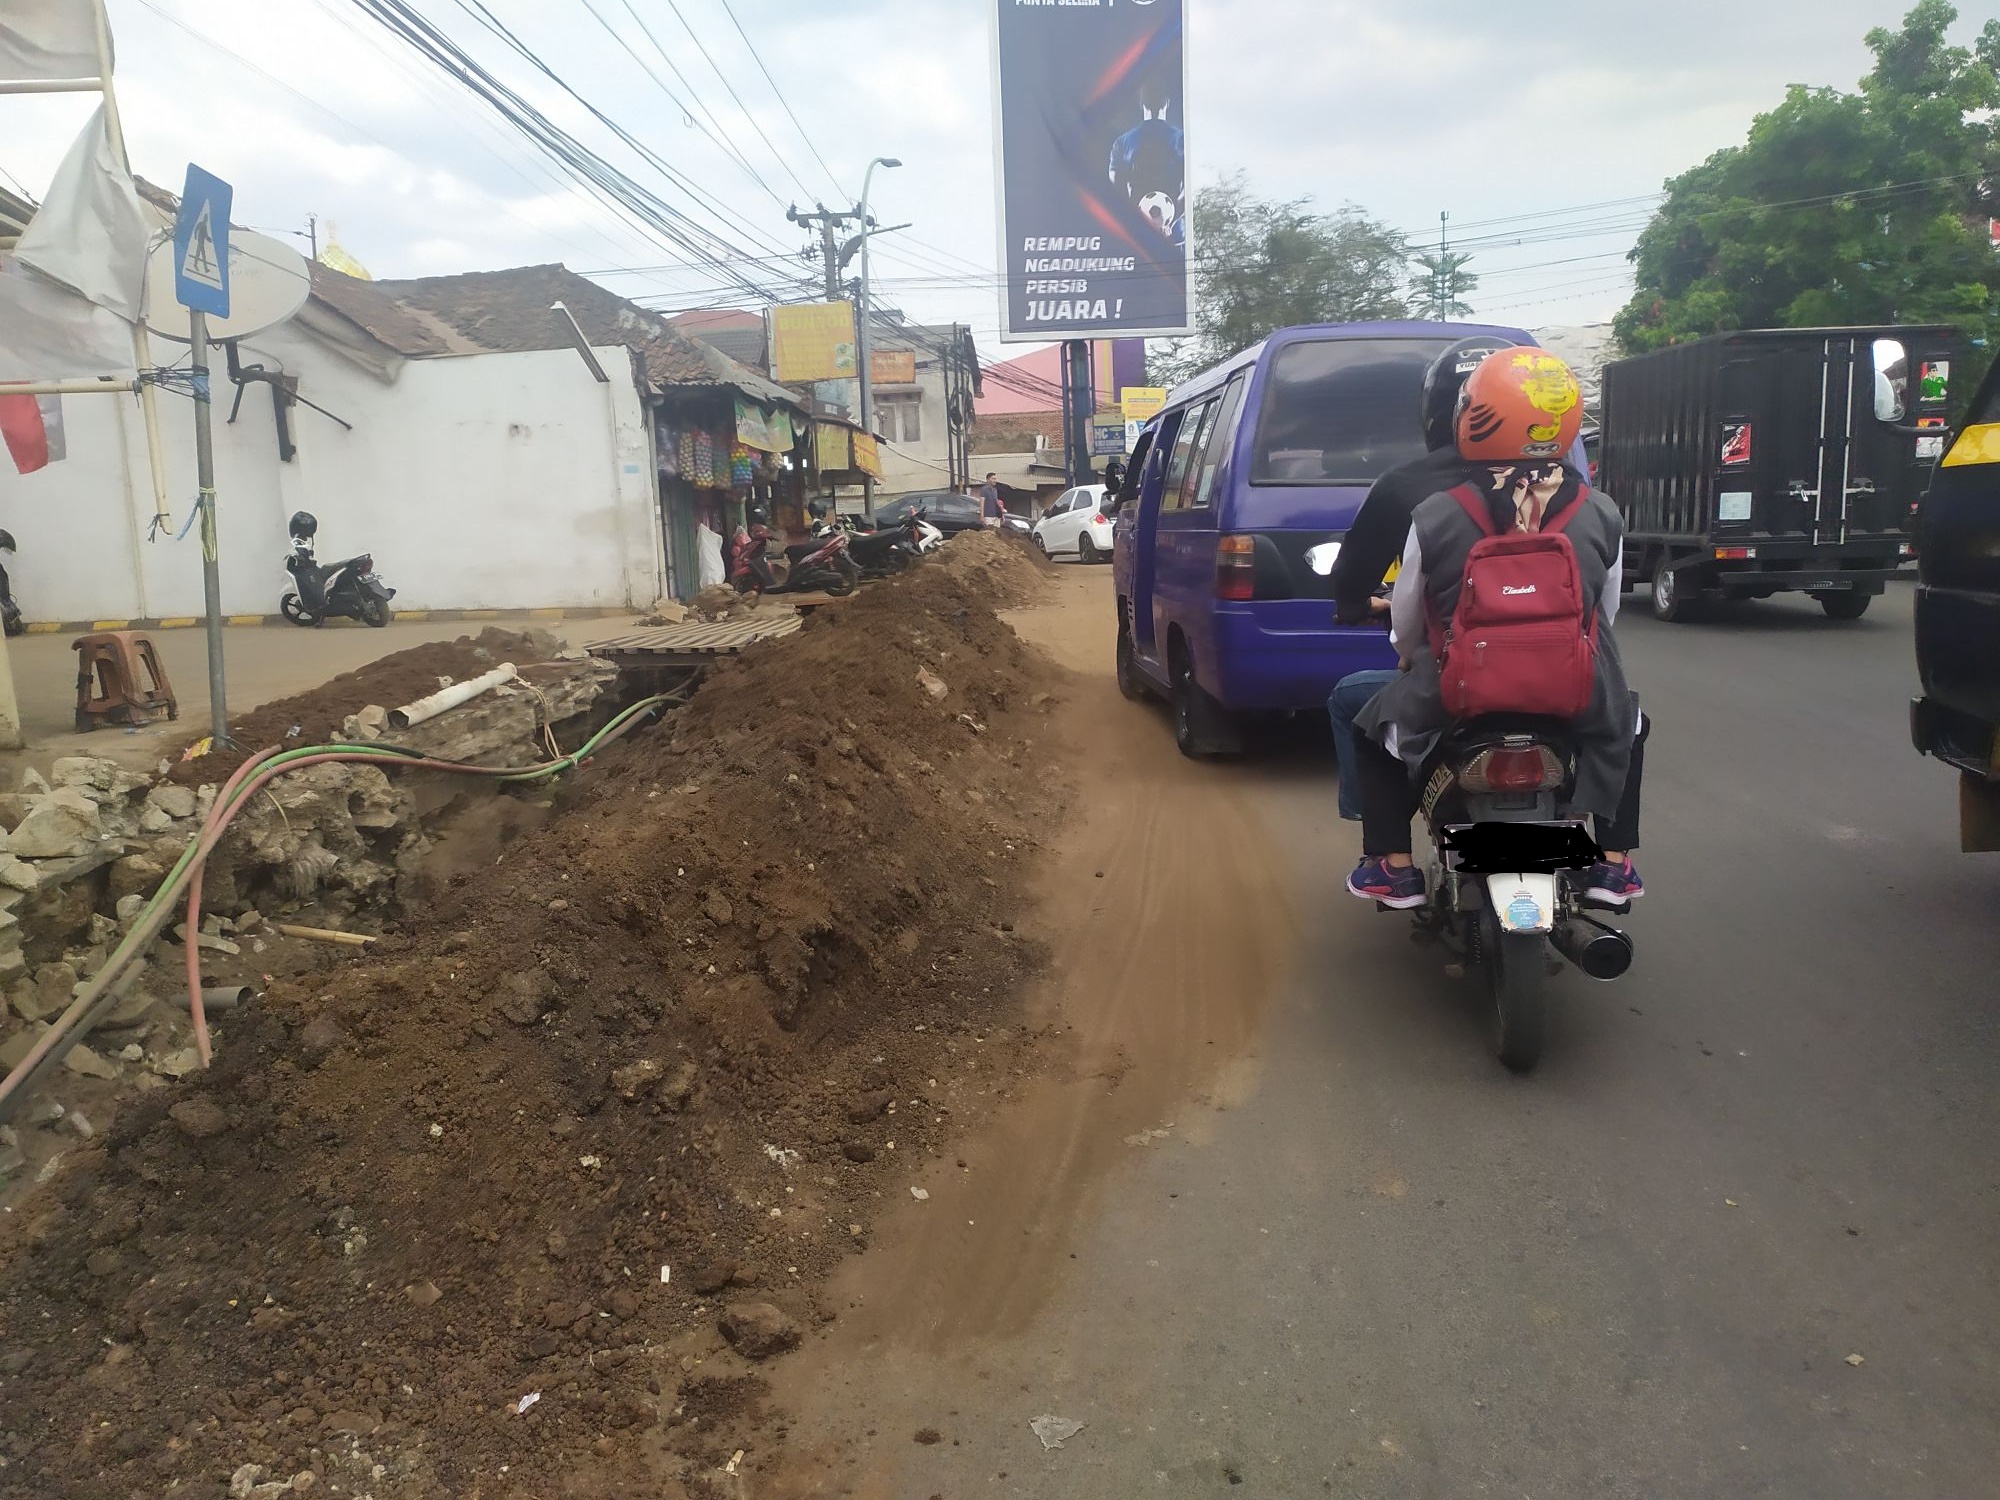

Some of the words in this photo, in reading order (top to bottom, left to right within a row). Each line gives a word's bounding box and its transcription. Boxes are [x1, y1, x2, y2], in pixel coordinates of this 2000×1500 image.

[1023, 236, 1101, 252] REMPUG
[1024, 256, 1135, 273] NGADUKUNG
[1026, 279, 1088, 294] PERSIB
[1025, 299, 1108, 321] JUARA
[1114, 298, 1123, 319] !
[1422, 763, 1452, 817] HONDA
